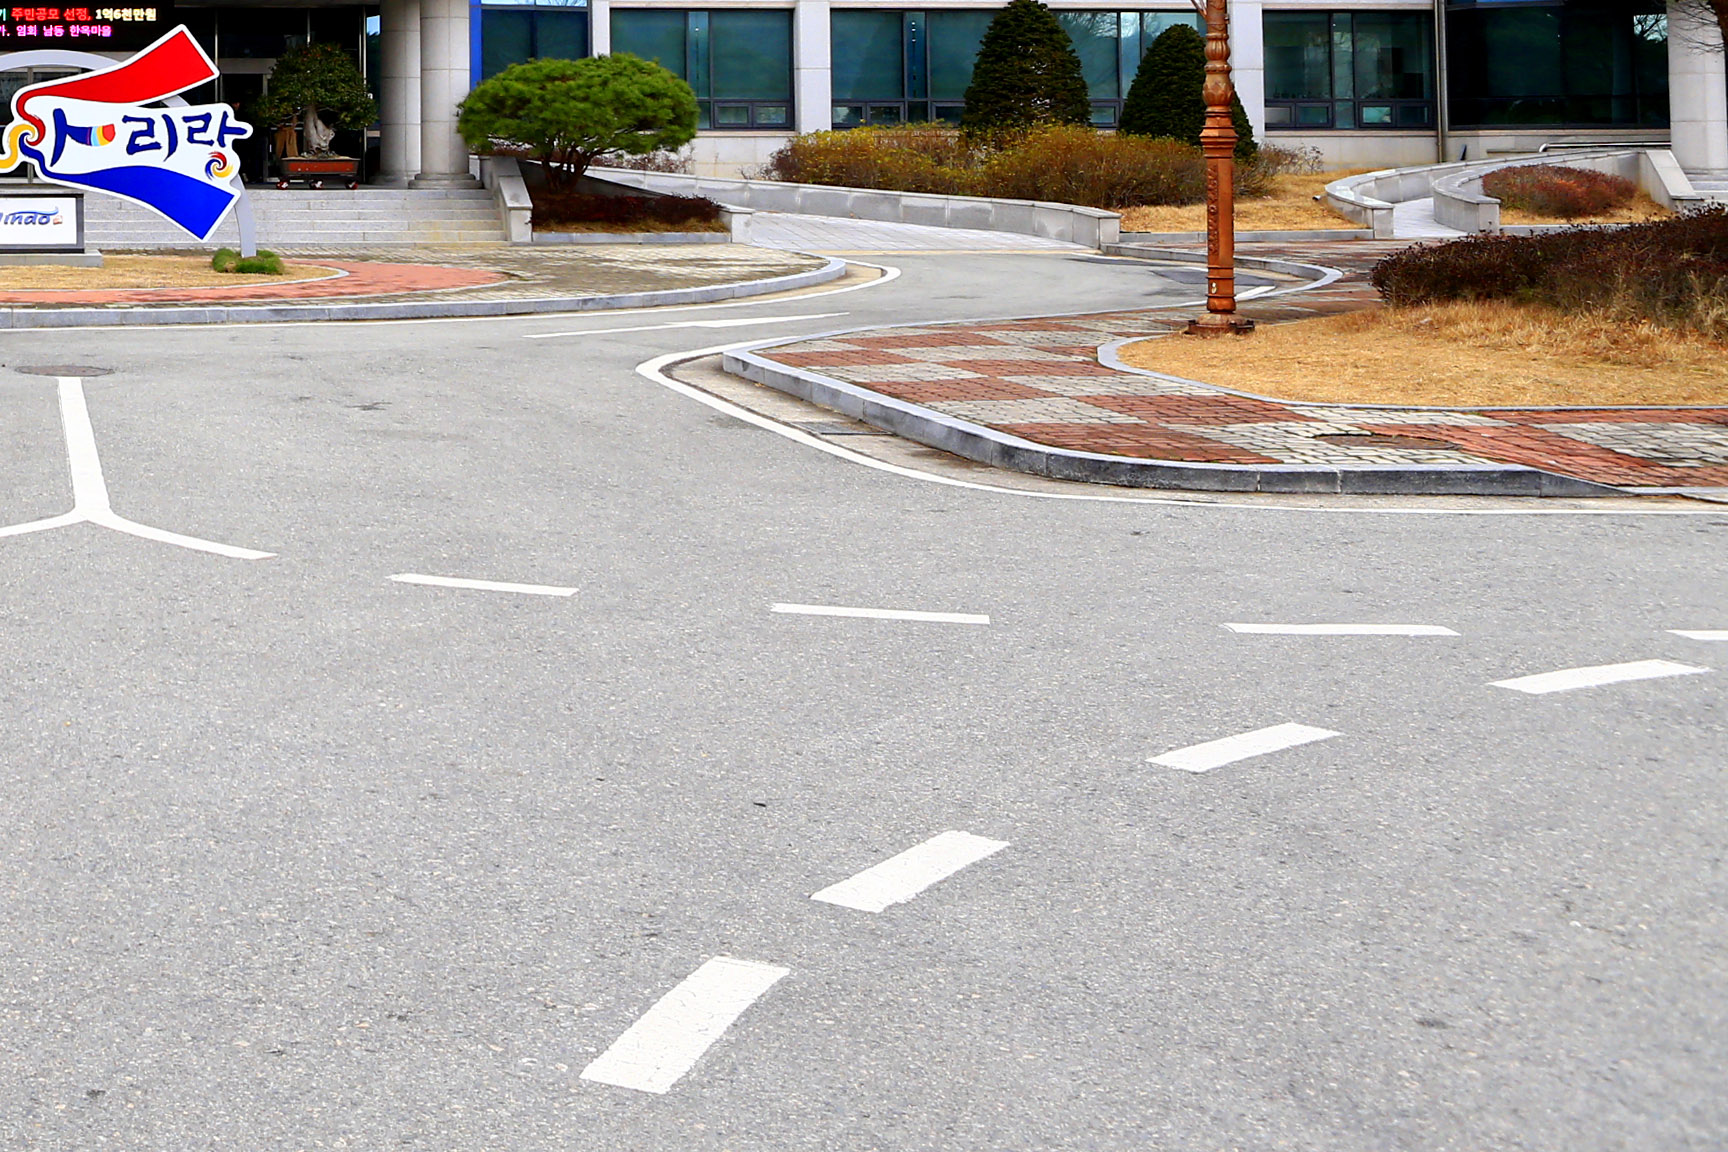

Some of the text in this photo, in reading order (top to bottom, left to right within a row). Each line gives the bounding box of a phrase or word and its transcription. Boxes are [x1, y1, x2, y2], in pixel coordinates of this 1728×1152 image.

[11, 8, 60, 22] 주민공모
[63, 8, 93, 22] 선정,
[95, 8, 157, 22] 1억6천만원
[16, 25, 38, 37] 임회
[42, 25, 65, 37] 남동
[69, 25, 112, 37] 한옥마을
